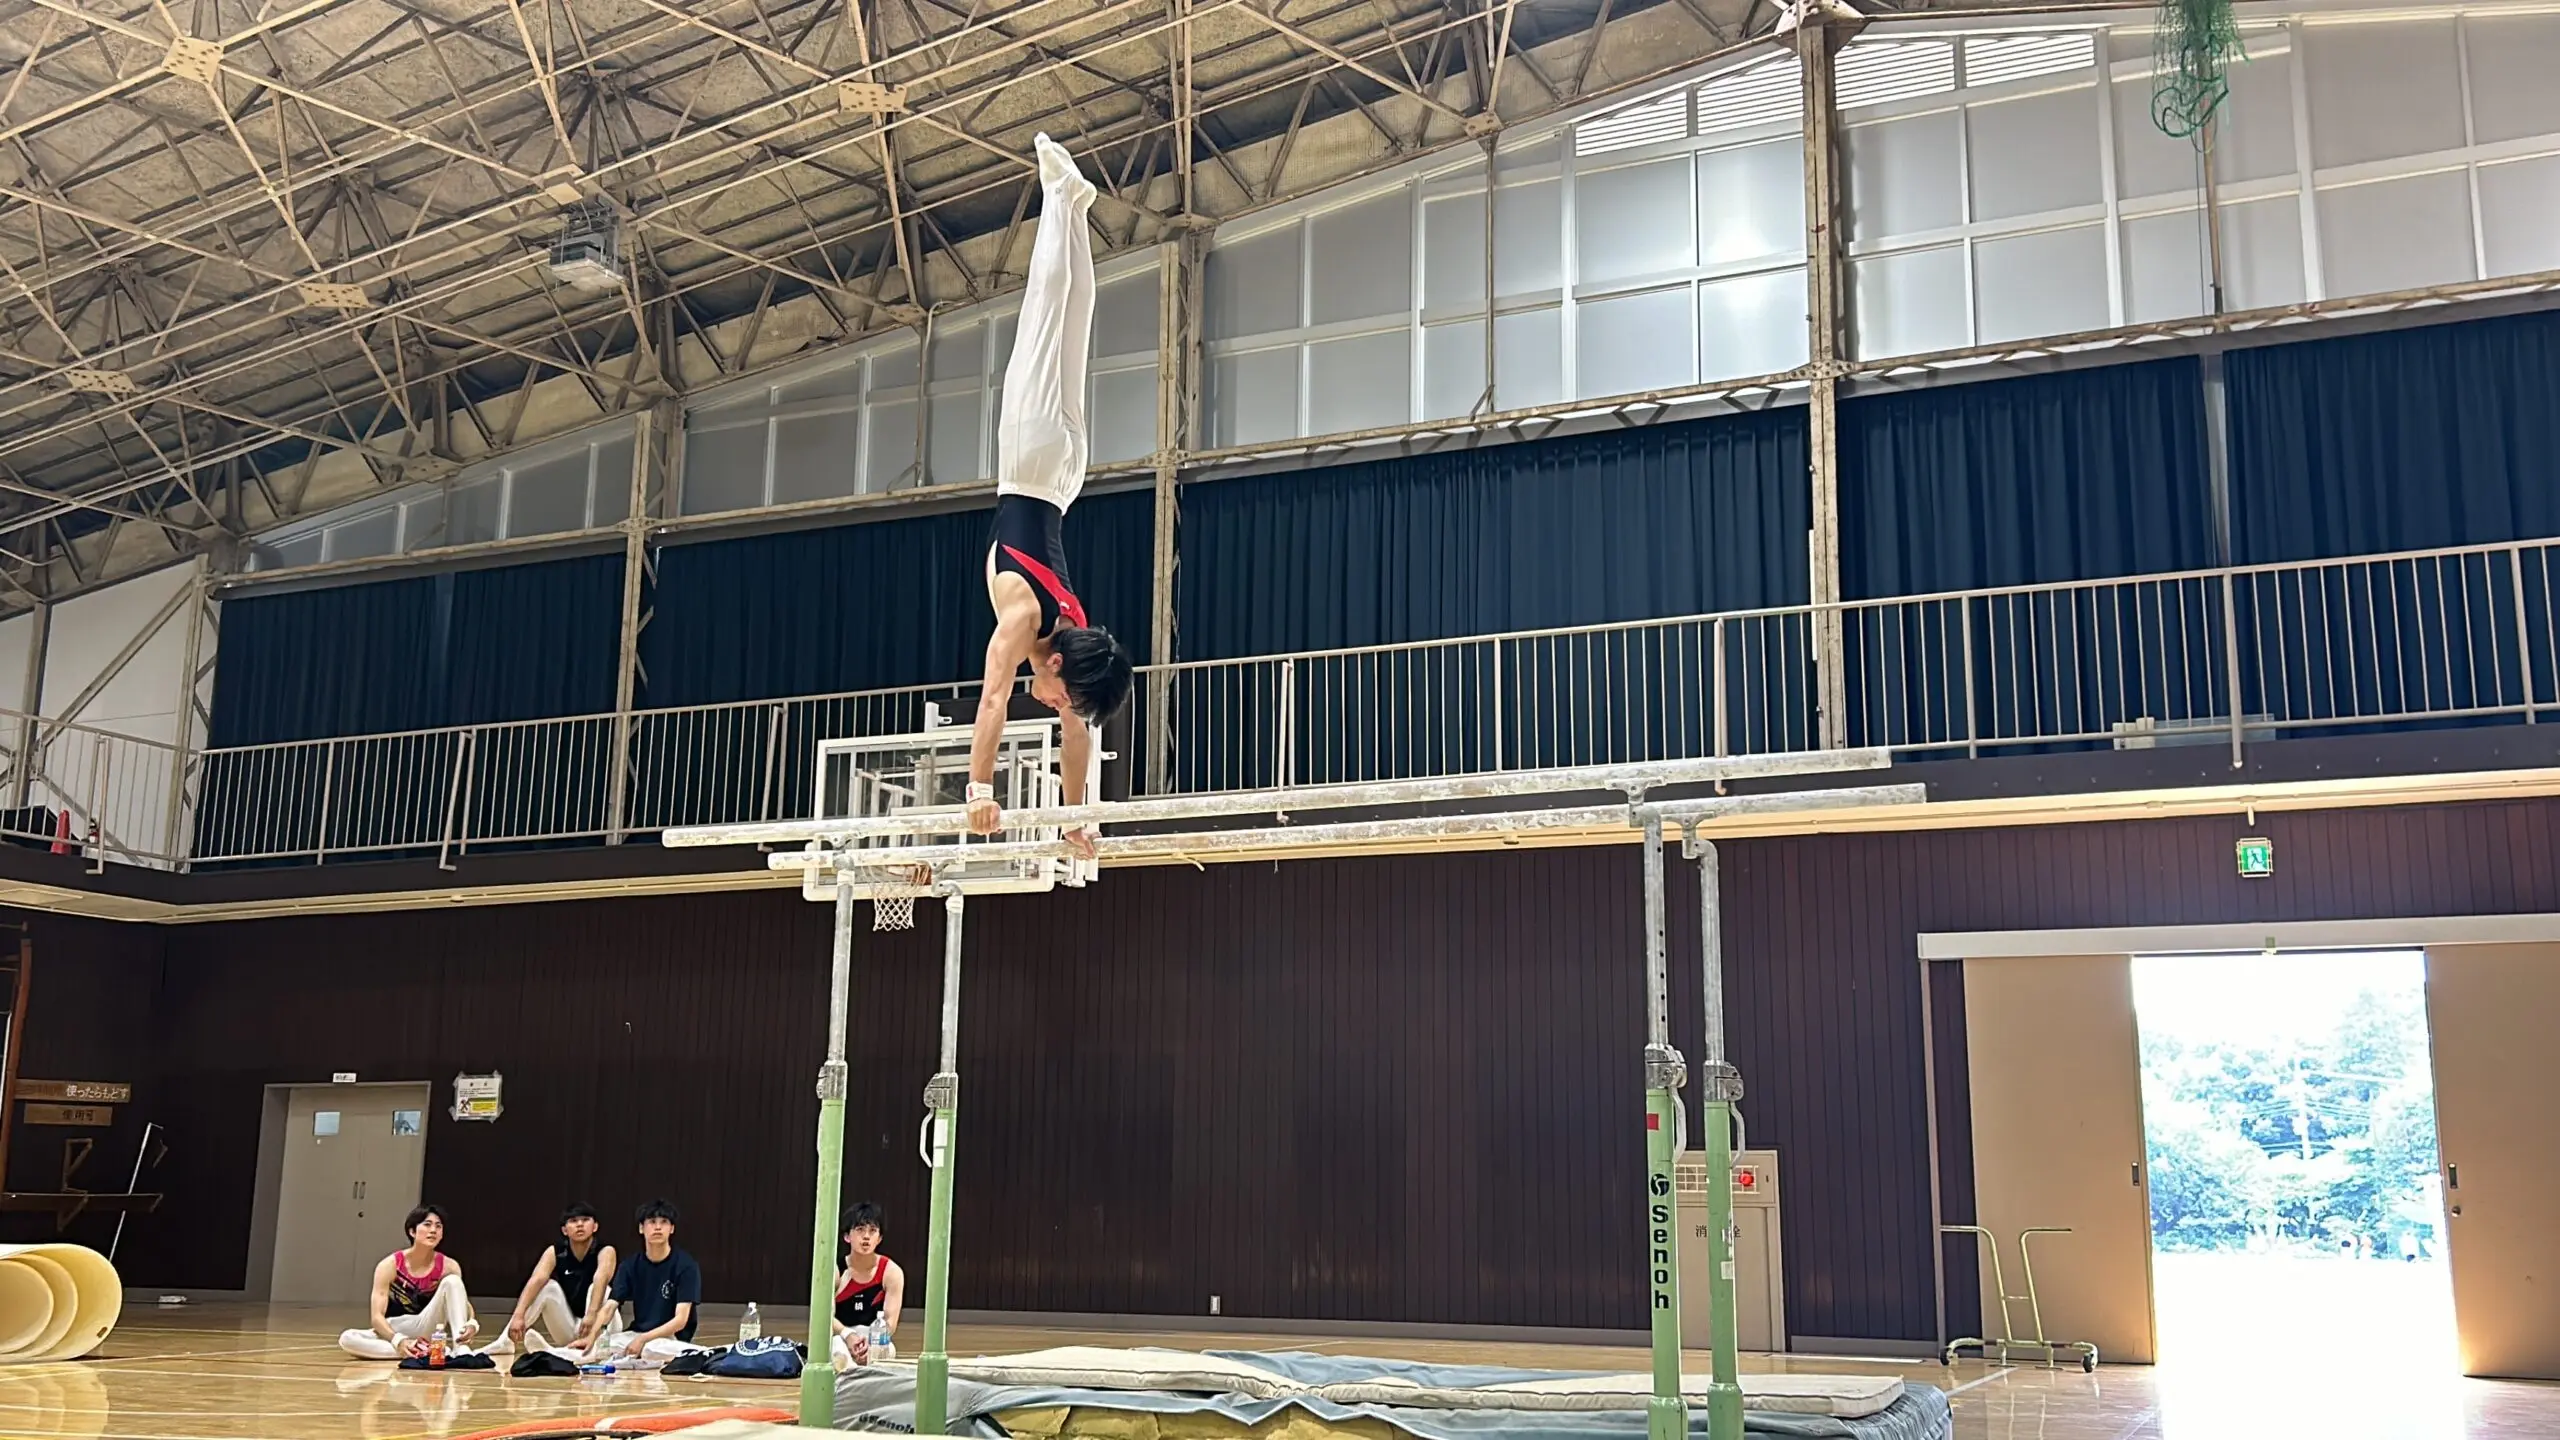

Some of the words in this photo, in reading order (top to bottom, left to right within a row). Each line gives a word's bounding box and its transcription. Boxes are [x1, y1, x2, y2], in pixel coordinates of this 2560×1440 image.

[66, 1084, 129, 1100] 使ったらもどす
[1652, 1204, 1669, 1309] Senoh
